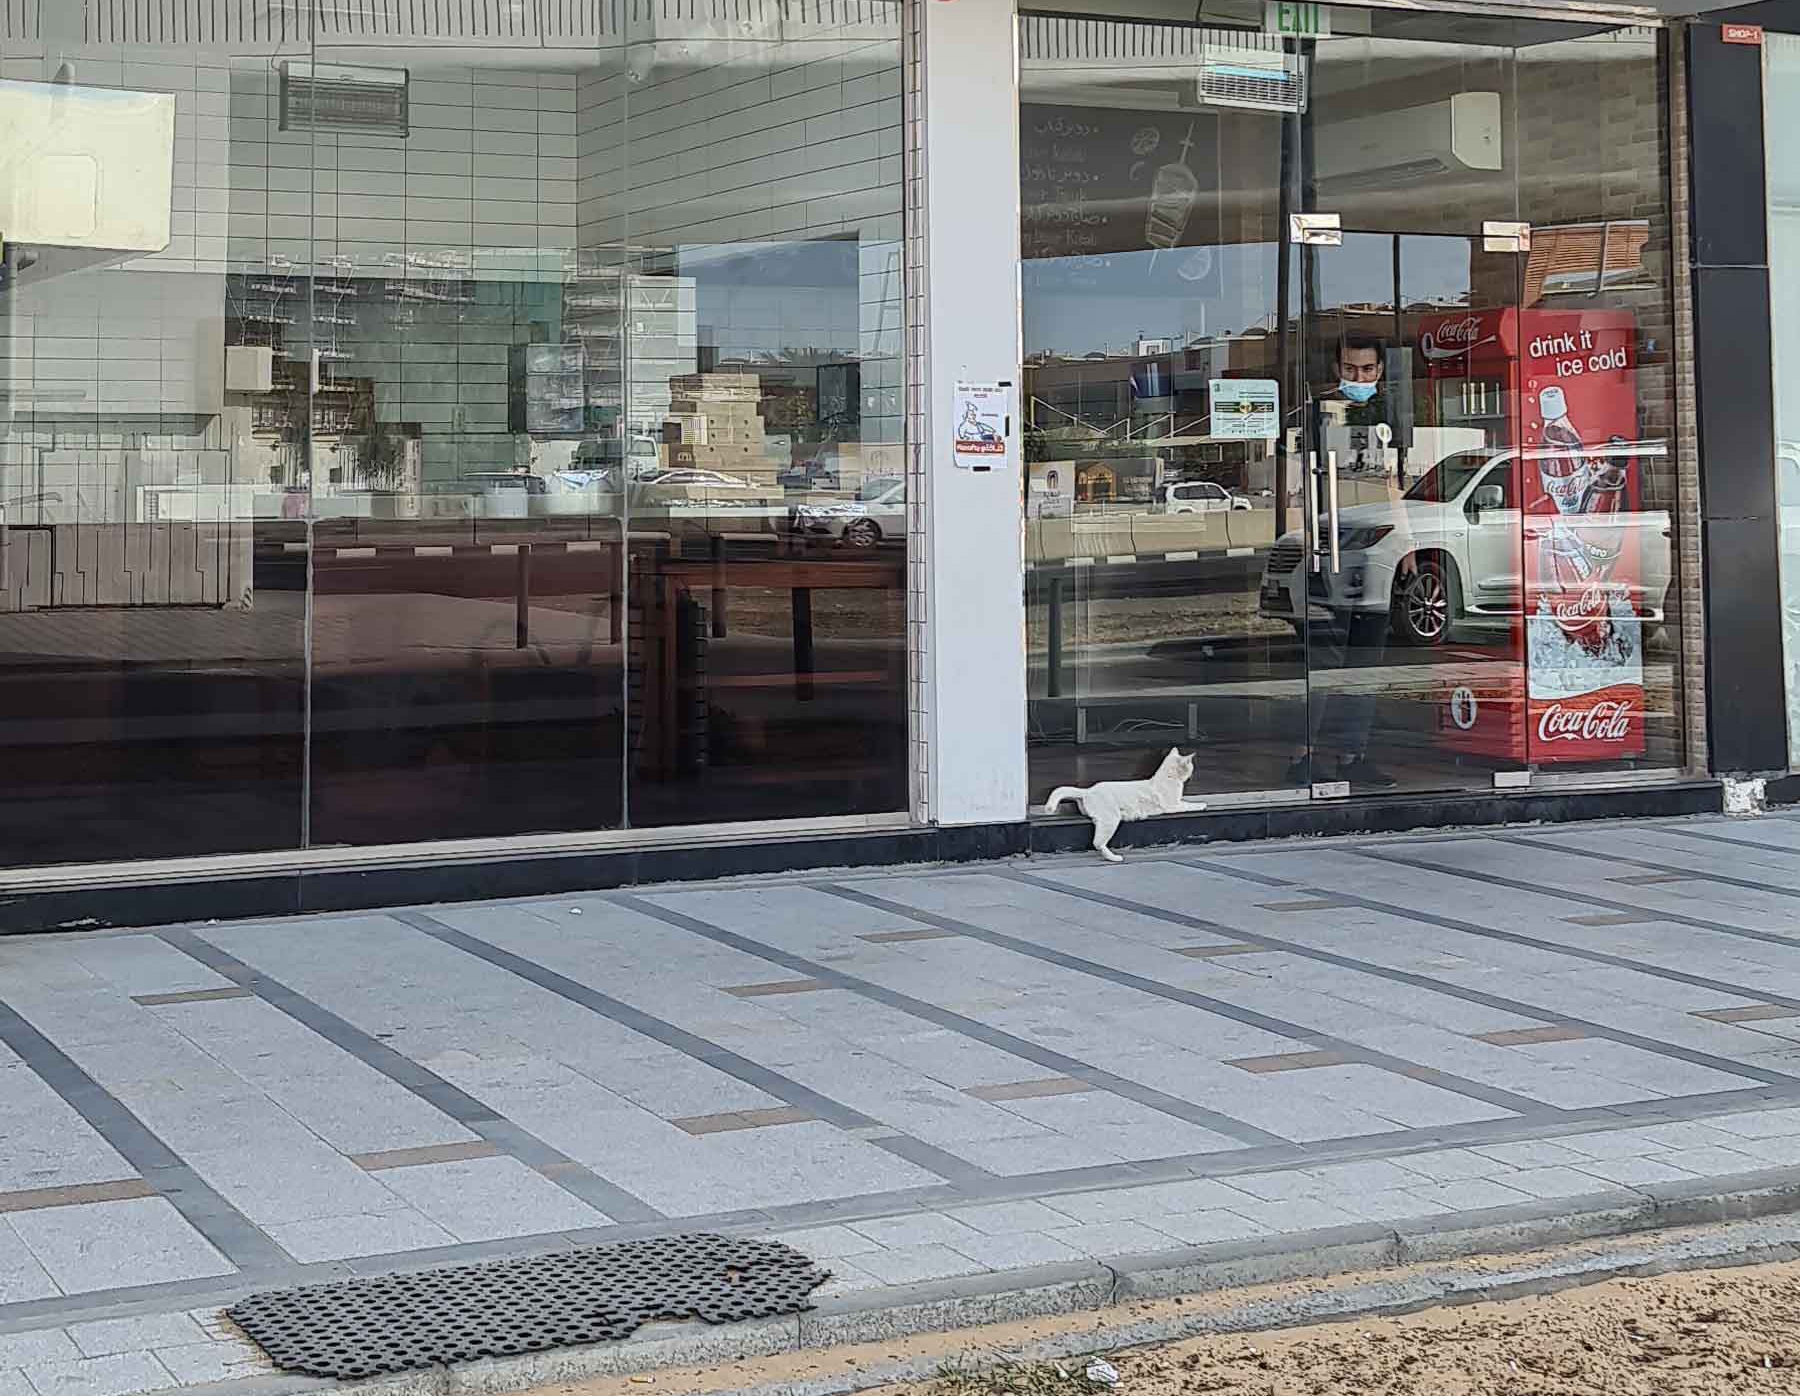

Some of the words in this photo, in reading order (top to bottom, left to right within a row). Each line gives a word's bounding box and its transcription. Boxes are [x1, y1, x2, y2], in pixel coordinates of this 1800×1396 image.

[1529, 331, 1577, 358] drink
[1580, 330, 1593, 350] it
[1556, 357, 1584, 377] ice
[1588, 347, 1628, 372] cold
